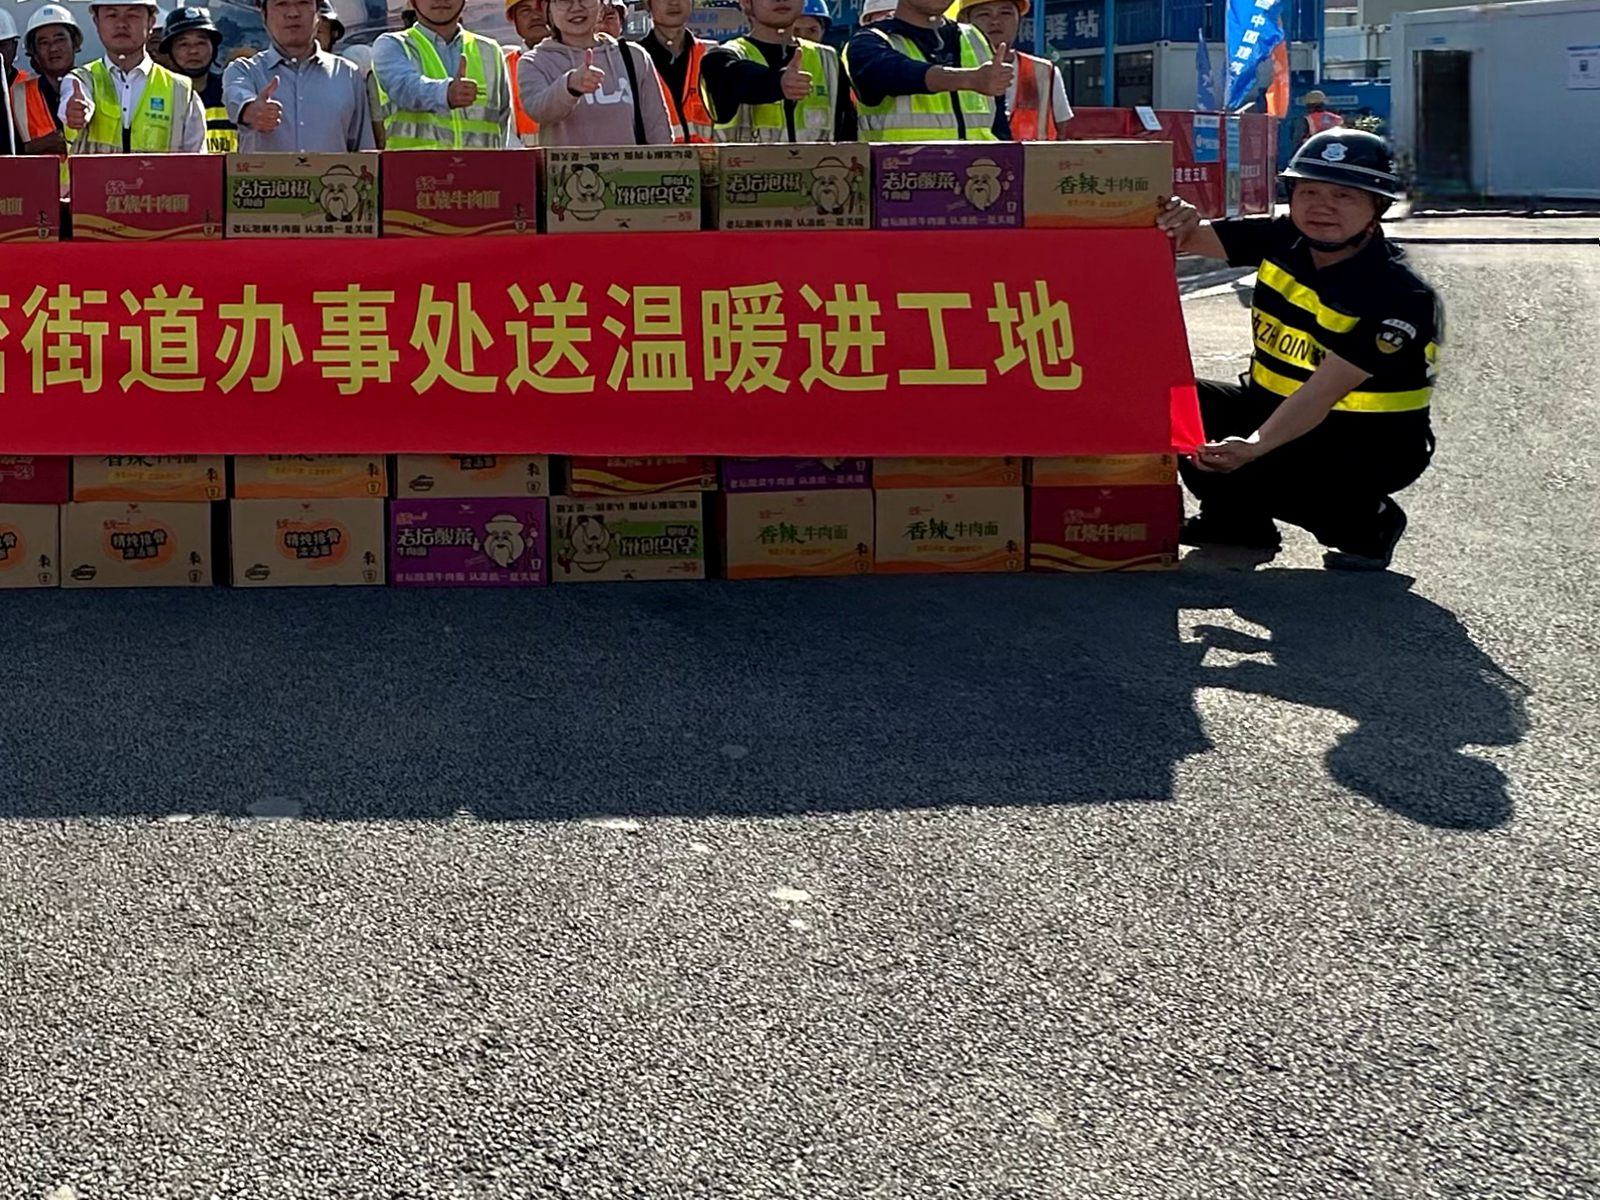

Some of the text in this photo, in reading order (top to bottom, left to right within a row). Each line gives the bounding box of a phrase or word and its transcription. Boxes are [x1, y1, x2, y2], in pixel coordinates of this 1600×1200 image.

[235, 179, 311, 198] 老坛泡椒
[727, 173, 802, 192] 老坛泡椒
[882, 171, 956, 190] 老坛酸菜
[1053, 172, 1149, 195] 香辣牛肉面
[1279, 333, 1311, 361] QIN
[397, 527, 474, 547] 老坛酸菜
[756, 521, 848, 545] 香辣牛肉面
[904, 517, 998, 541] 香辣牛肉面
